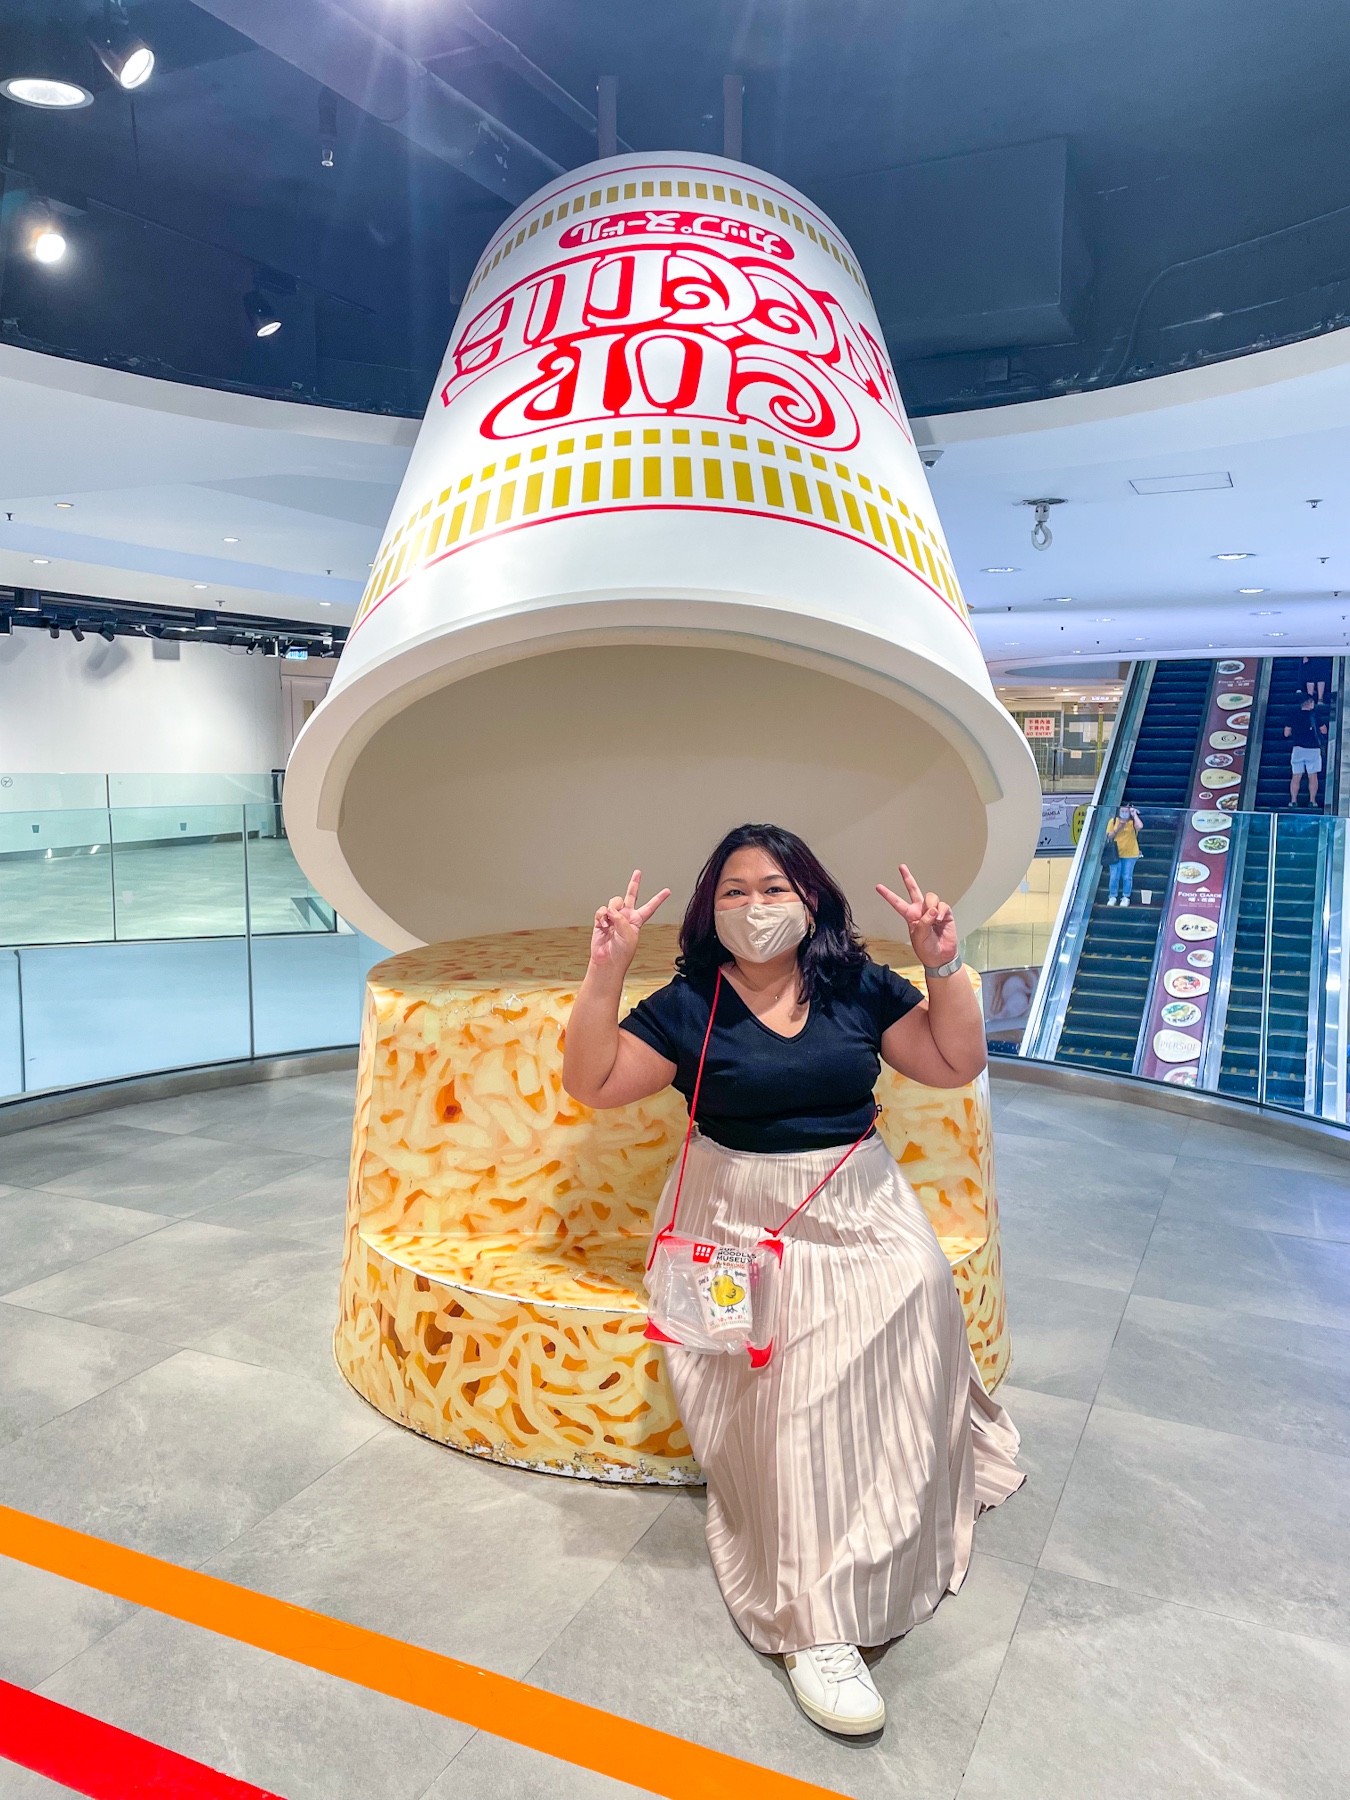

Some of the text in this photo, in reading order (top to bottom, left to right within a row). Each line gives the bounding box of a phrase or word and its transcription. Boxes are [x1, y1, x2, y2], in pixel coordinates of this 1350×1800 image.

[569, 211, 784, 256] カップヌードル
[479, 328, 861, 453] CUP
[716, 1255, 753, 1264] MUSEUM
